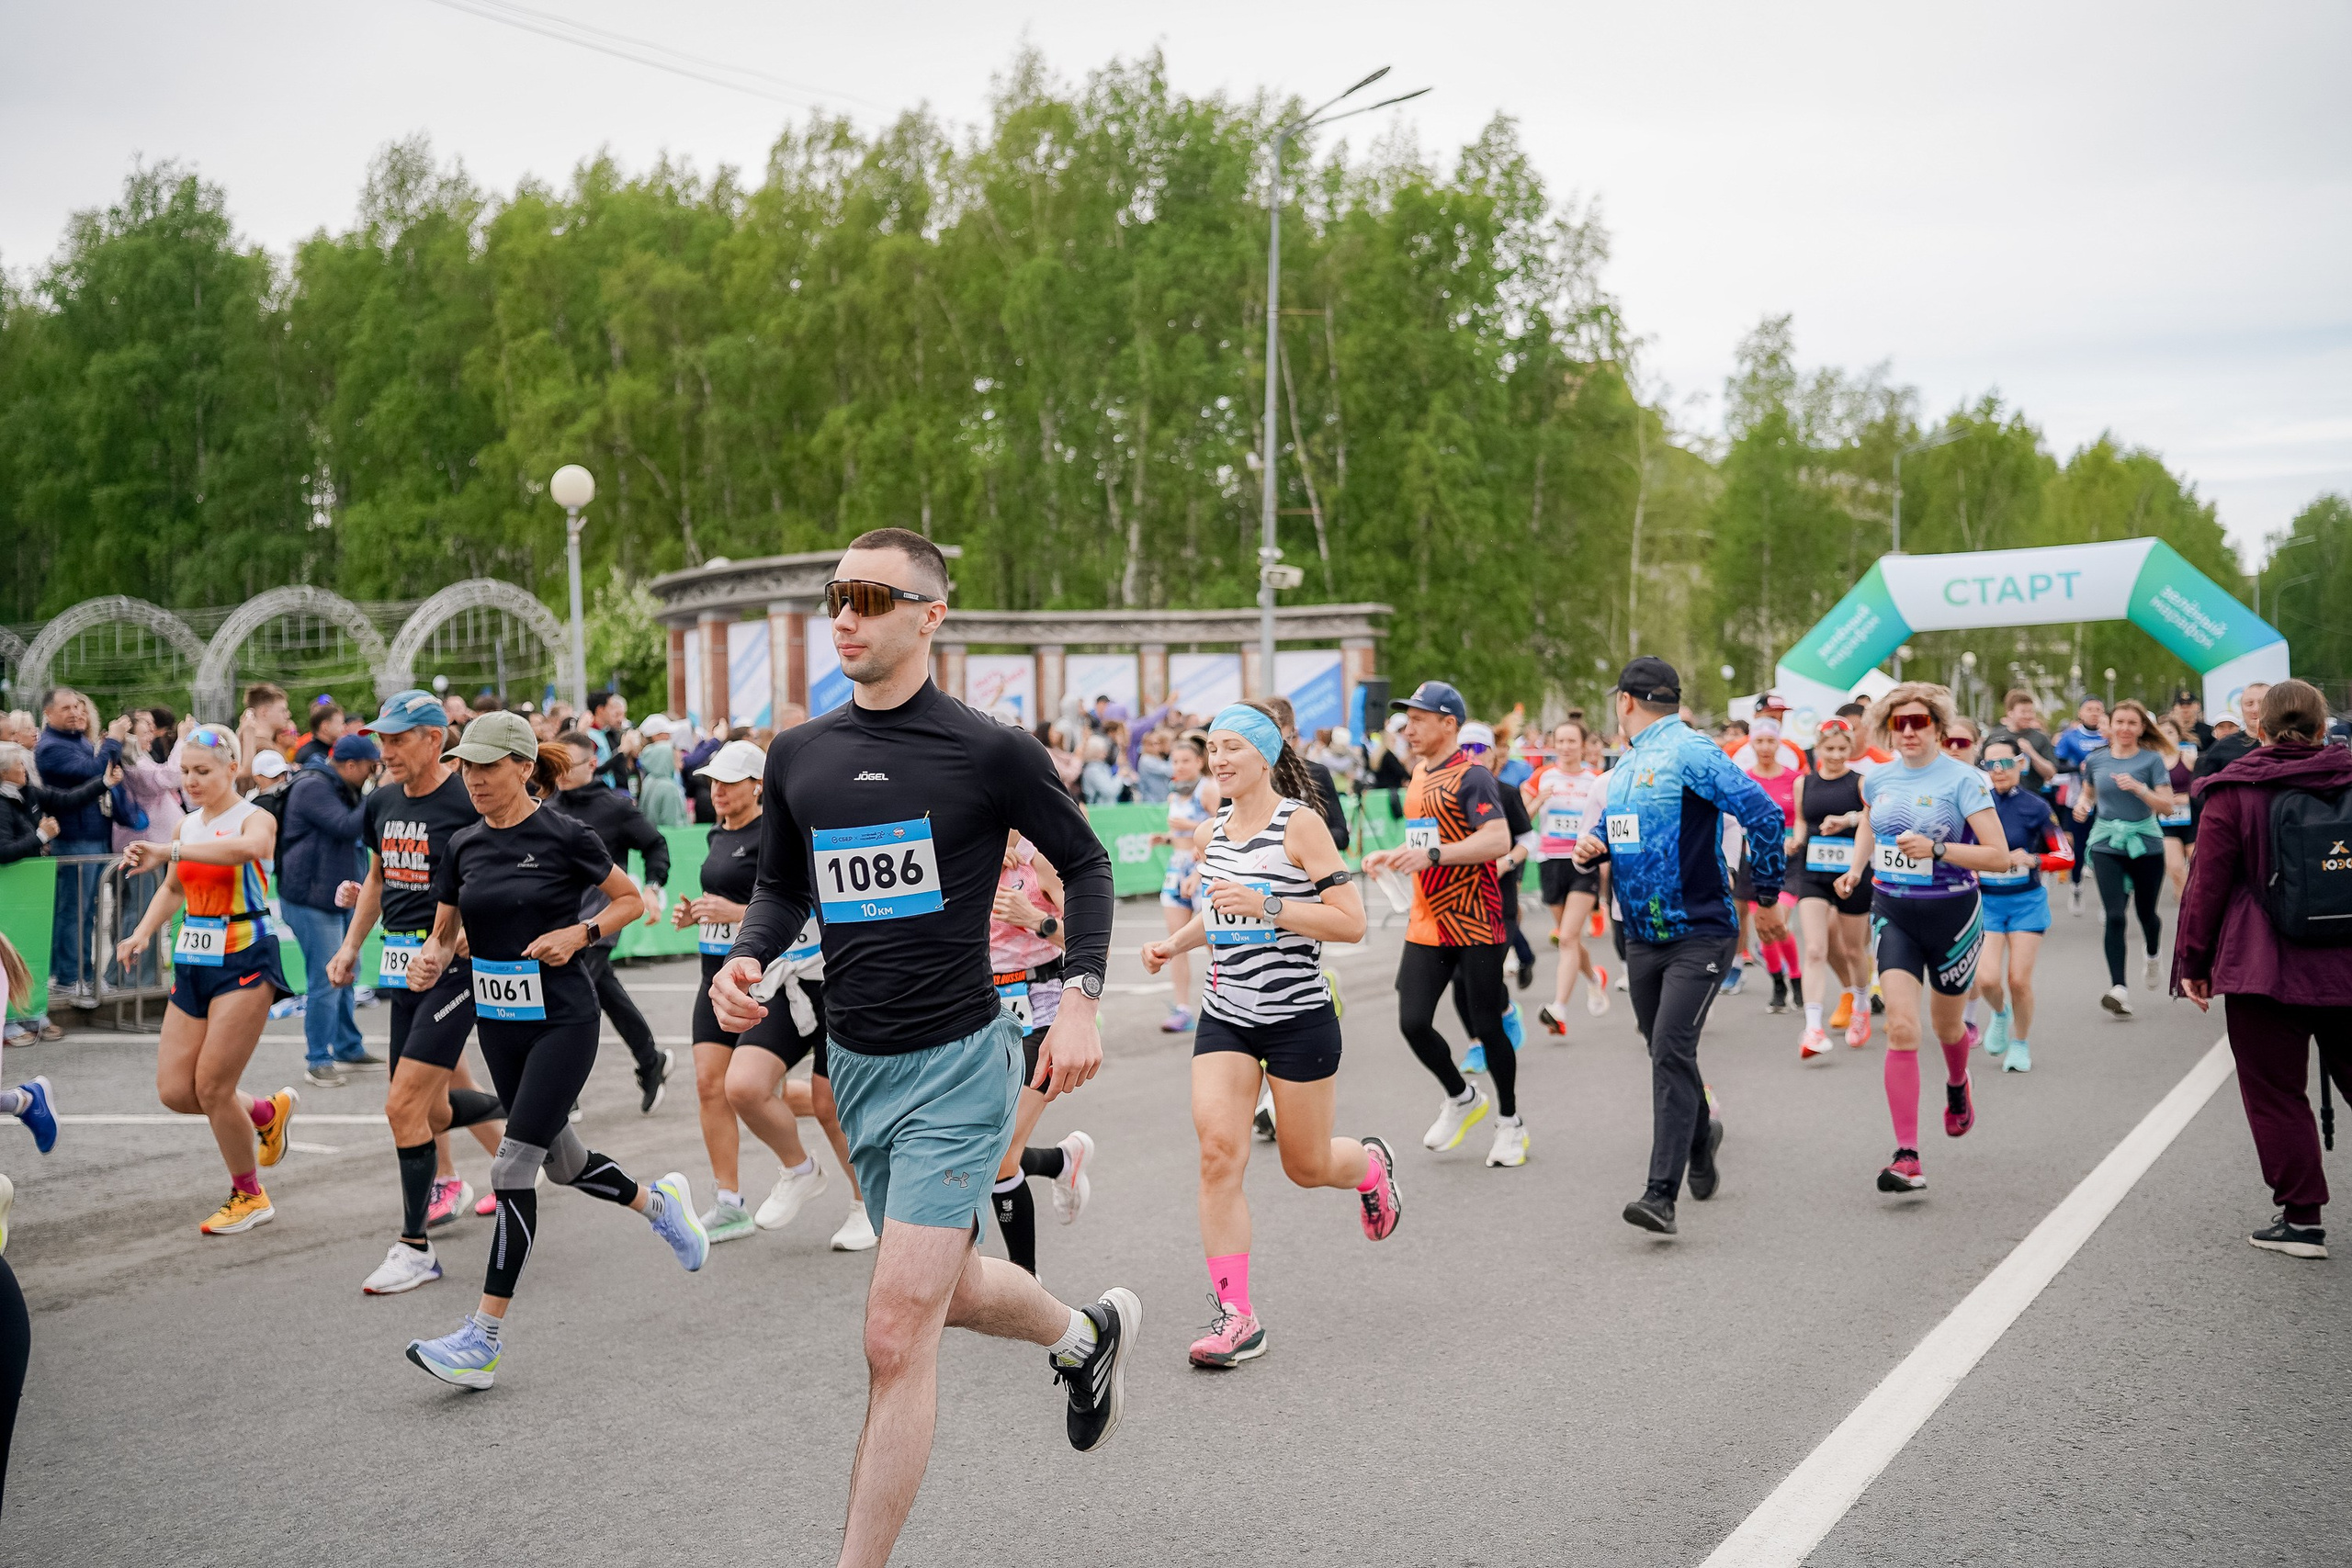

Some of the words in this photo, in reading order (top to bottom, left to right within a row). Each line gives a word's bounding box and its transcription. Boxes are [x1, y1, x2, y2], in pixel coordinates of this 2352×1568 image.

[1943, 571, 2081, 607] СТАРТ
[854, 771, 889, 781] JÖGEL
[383, 820, 429, 840] URAL
[1611, 819, 1629, 838] 804
[381, 838, 430, 855] ULTRA
[1410, 831, 1429, 848] 647
[381, 851, 430, 871] TRAIL
[1818, 849, 1845, 861] 590
[828, 849, 924, 893] 1086
[184, 931, 211, 950] 730
[385, 952, 410, 971] 789
[1001, 970, 1026, 985] RUSSIA
[479, 977, 532, 1002] 1061
